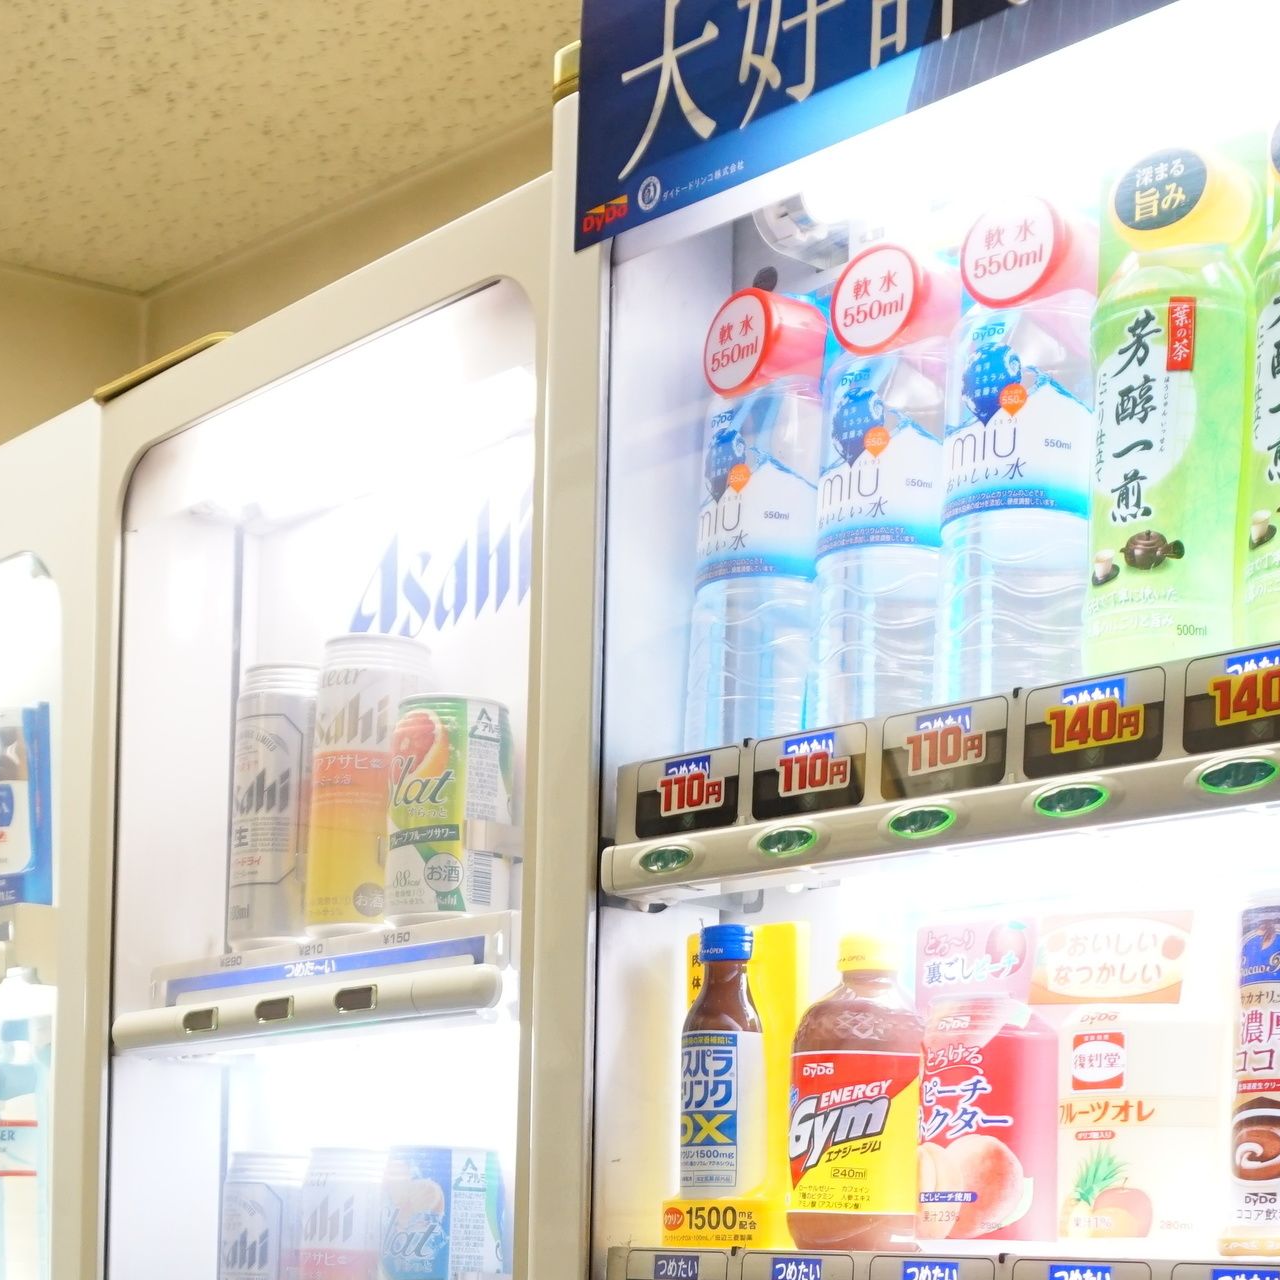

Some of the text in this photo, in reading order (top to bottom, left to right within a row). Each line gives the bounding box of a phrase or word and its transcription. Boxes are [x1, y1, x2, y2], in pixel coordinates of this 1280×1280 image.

[1135, 158, 1185, 187] 深まる
[1134, 182, 1186, 222] 旨み
[582, 203, 629, 234] DyDo
[973, 243, 1044, 280] 550ml
[842, 292, 905, 328] 550ml
[1171, 303, 1191, 361] 葉の茶
[710, 339, 759, 373] 550ml
[1111, 308, 1162, 523] 芳醇一煎
[1043, 438, 1073, 451] 550ml
[905, 477, 933, 489] 550ml
[763, 510, 790, 521] 550ml
[1176, 624, 1208, 637] 500ml
[1047, 698, 1140, 748] 140円
[906, 724, 984, 771] 110円
[778, 750, 849, 793] 110円
[660, 771, 723, 813] 110円
[426, 864, 460, 883] お酒
[383, 931, 410, 944] ¥150
[1070, 933, 1158, 955] おいしい
[1053, 962, 1162, 986] なつかしい
[937, 1014, 971, 1031] DyDo
[926, 1044, 983, 1068] とろける
[1073, 1052, 1123, 1070] 復刻堂
[802, 1062, 835, 1079] DyDo
[820, 1078, 893, 1108] ENERGY
[923, 1077, 988, 1103] ピーチ
[788, 1095, 891, 1169] Gym
[825, 1139, 882, 1163] エナジージム
[832, 1167, 866, 1179] 240ml
[1244, 1191, 1278, 1206] DyDo
[686, 1206, 753, 1230] 1500 mg
[738, 1220, 757, 1230] 配合
[656, 1256, 698, 1279] つめたい
